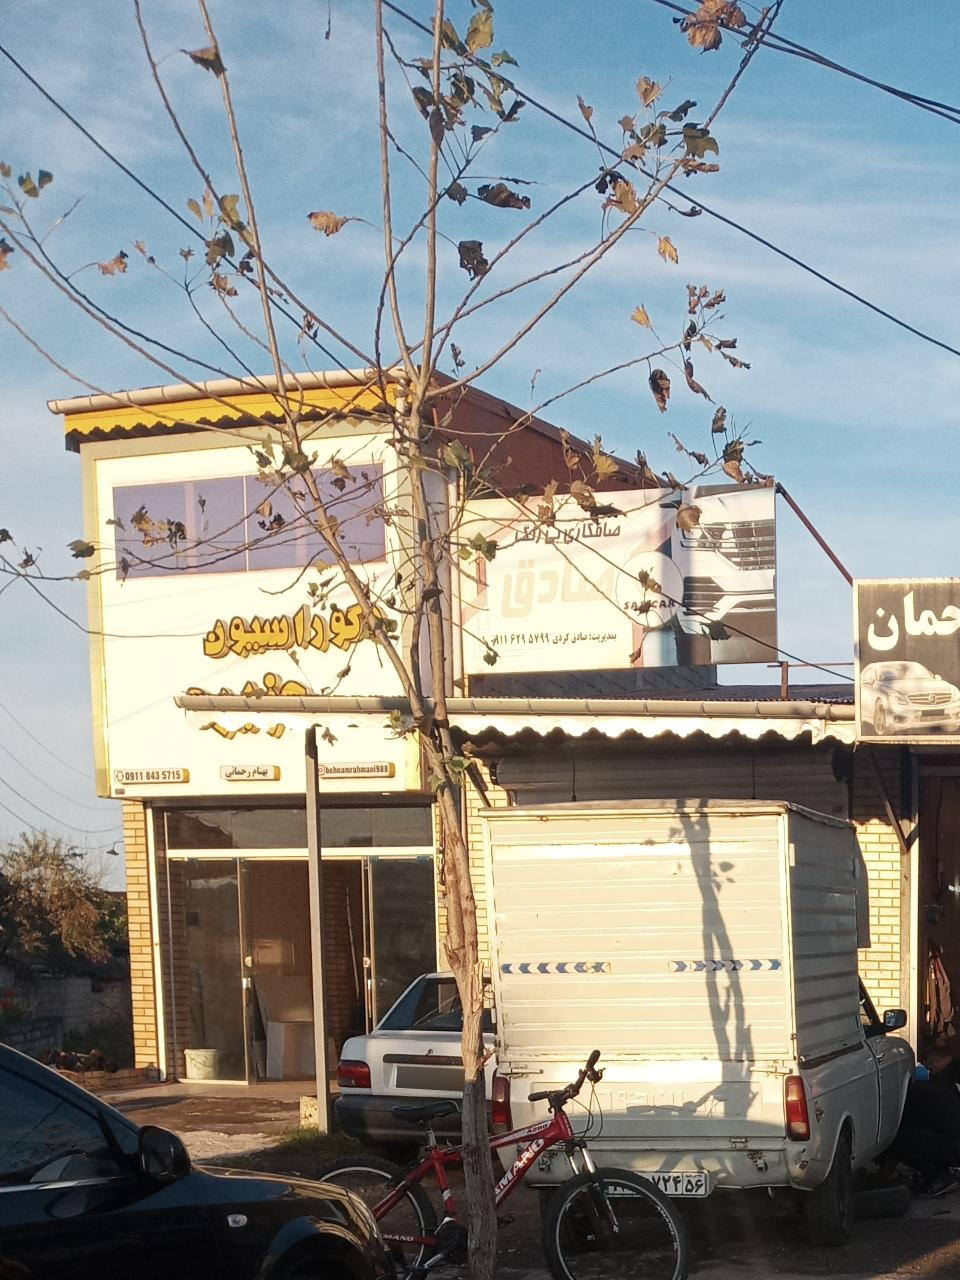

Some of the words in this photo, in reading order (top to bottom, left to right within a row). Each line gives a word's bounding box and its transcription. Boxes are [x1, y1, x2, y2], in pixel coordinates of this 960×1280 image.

[125, 771, 143, 781] 0911
[145, 770, 160, 780] 843
[162, 770, 181, 780] 5715
[224, 765, 251, 778] رحمانی
[252, 765, 268, 778] بهنام
[685, 1178, 704, 1193] ۵۶
